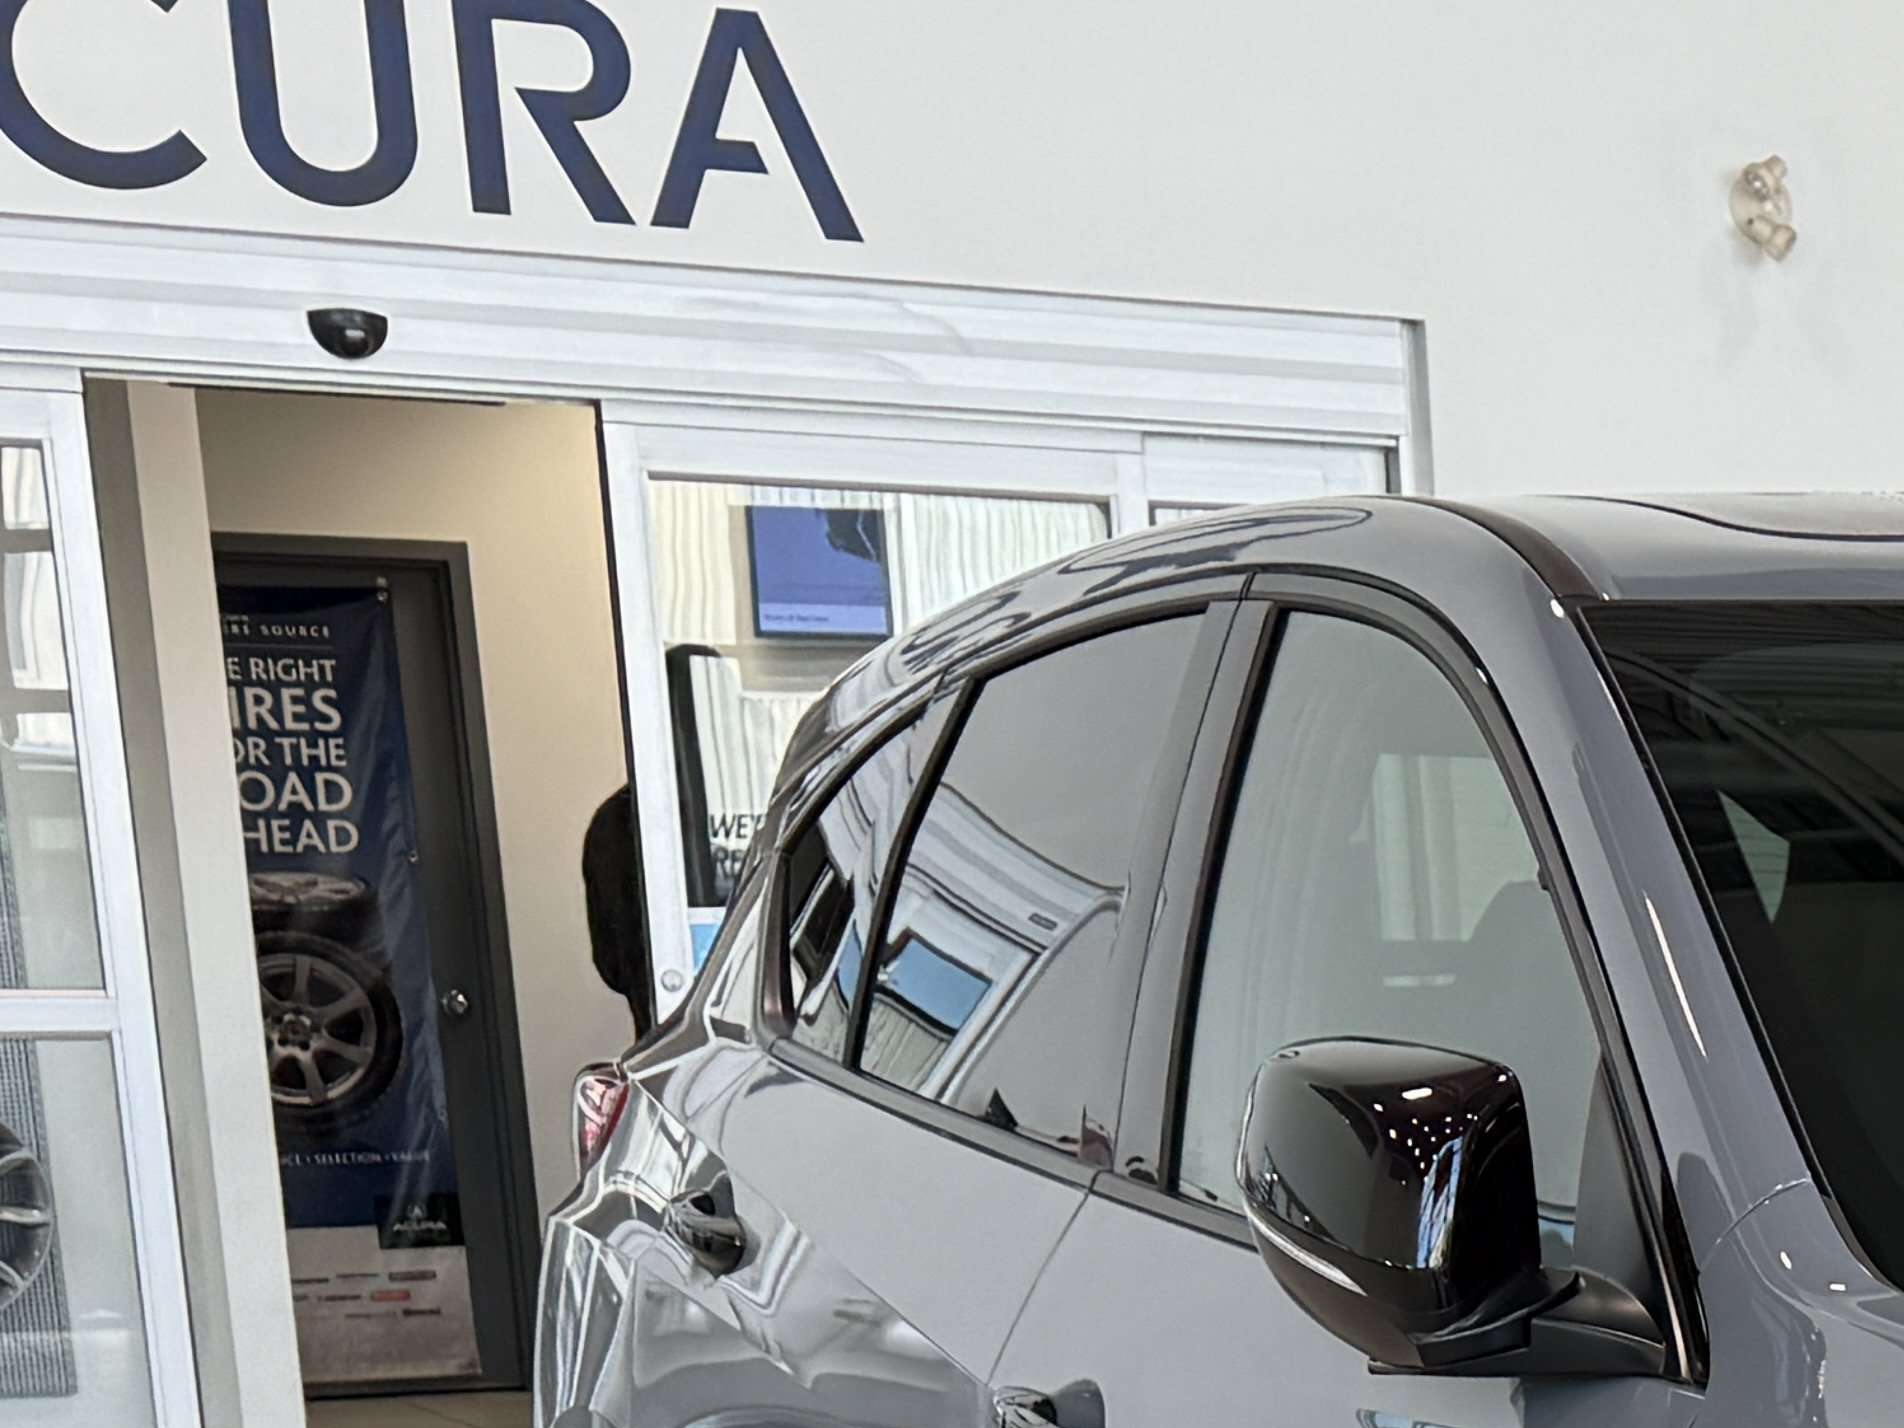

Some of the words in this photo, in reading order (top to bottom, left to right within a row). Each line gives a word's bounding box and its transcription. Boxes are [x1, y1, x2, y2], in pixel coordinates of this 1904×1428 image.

[249, 657, 337, 682] RIGHT
[274, 737, 348, 767] THE
[239, 769, 353, 812] OAD
